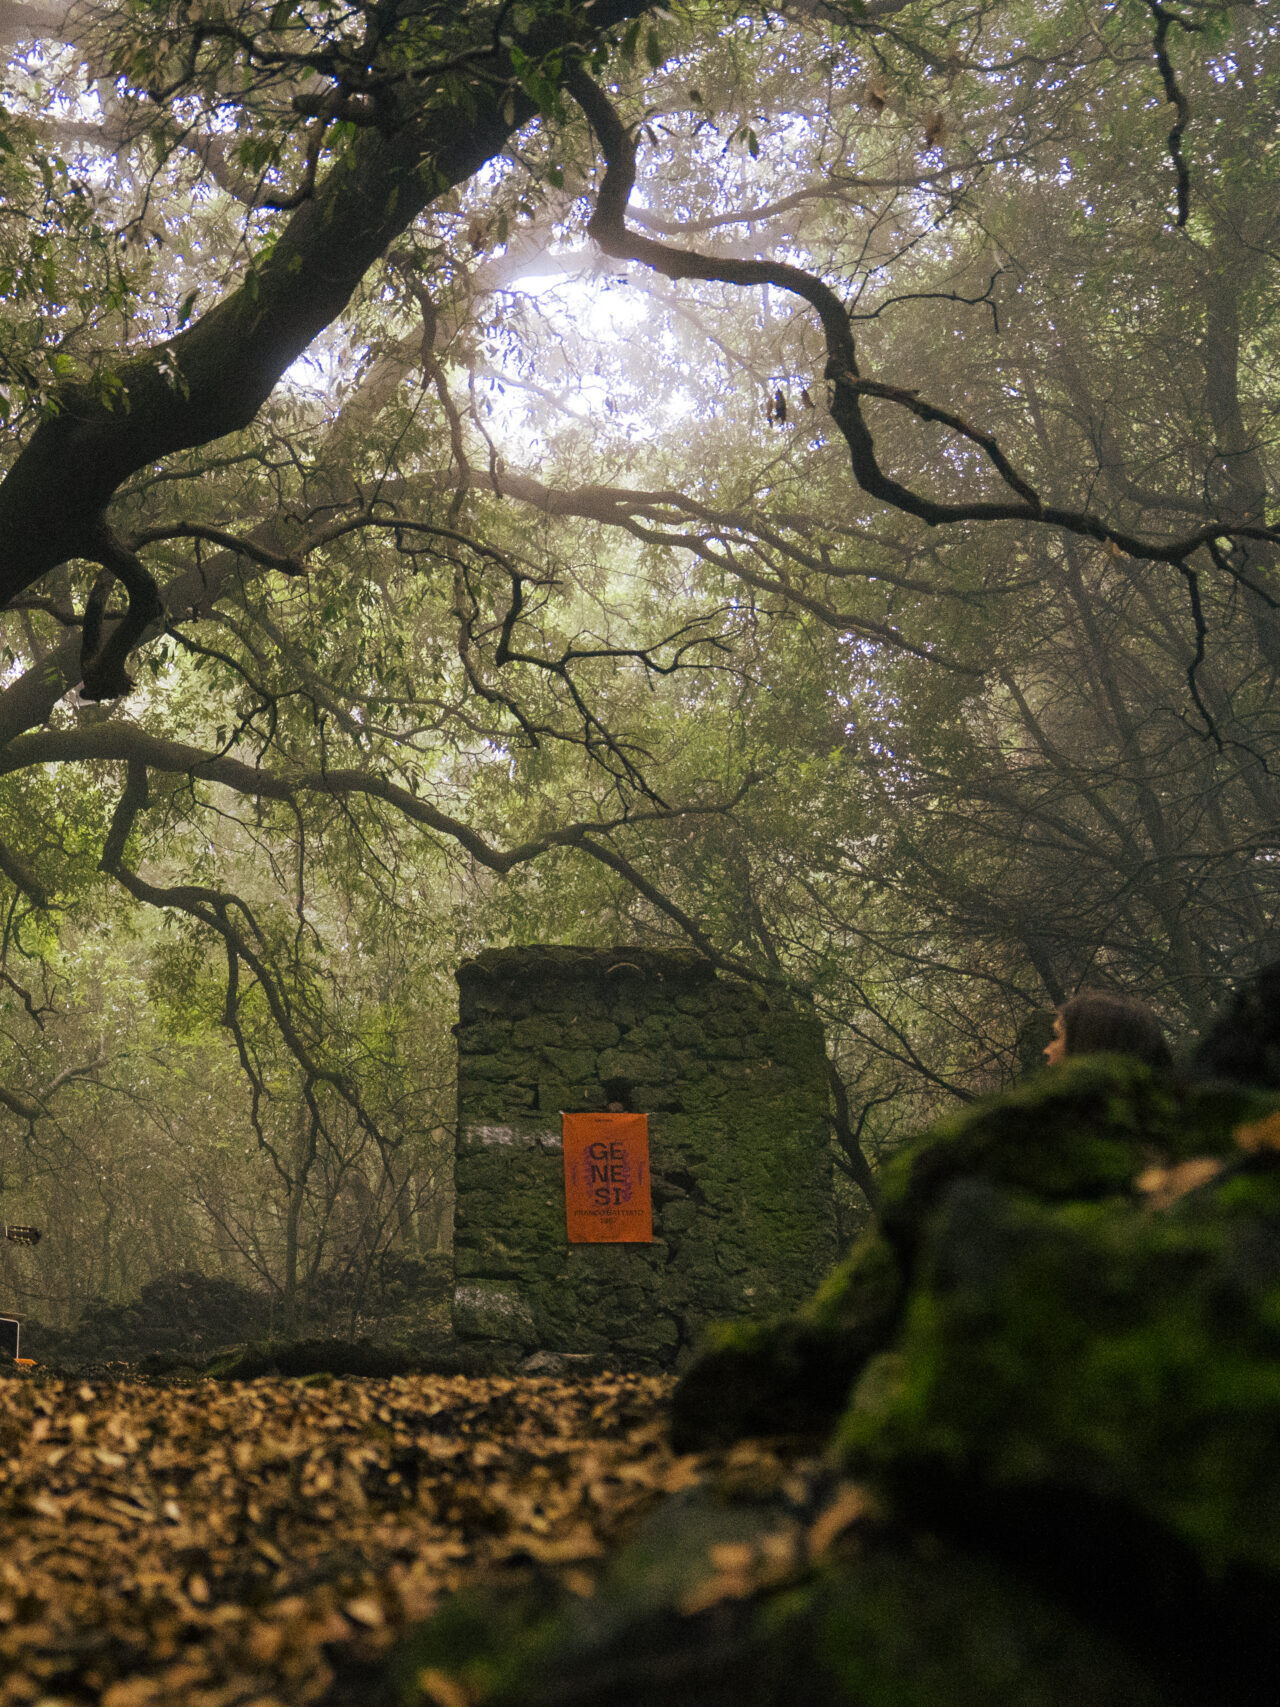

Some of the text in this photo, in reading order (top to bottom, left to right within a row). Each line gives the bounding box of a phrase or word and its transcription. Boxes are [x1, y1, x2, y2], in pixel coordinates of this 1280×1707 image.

[590, 1142, 625, 1160] GE
[591, 1165, 625, 1183] NE
[595, 1188, 622, 1206] SI
